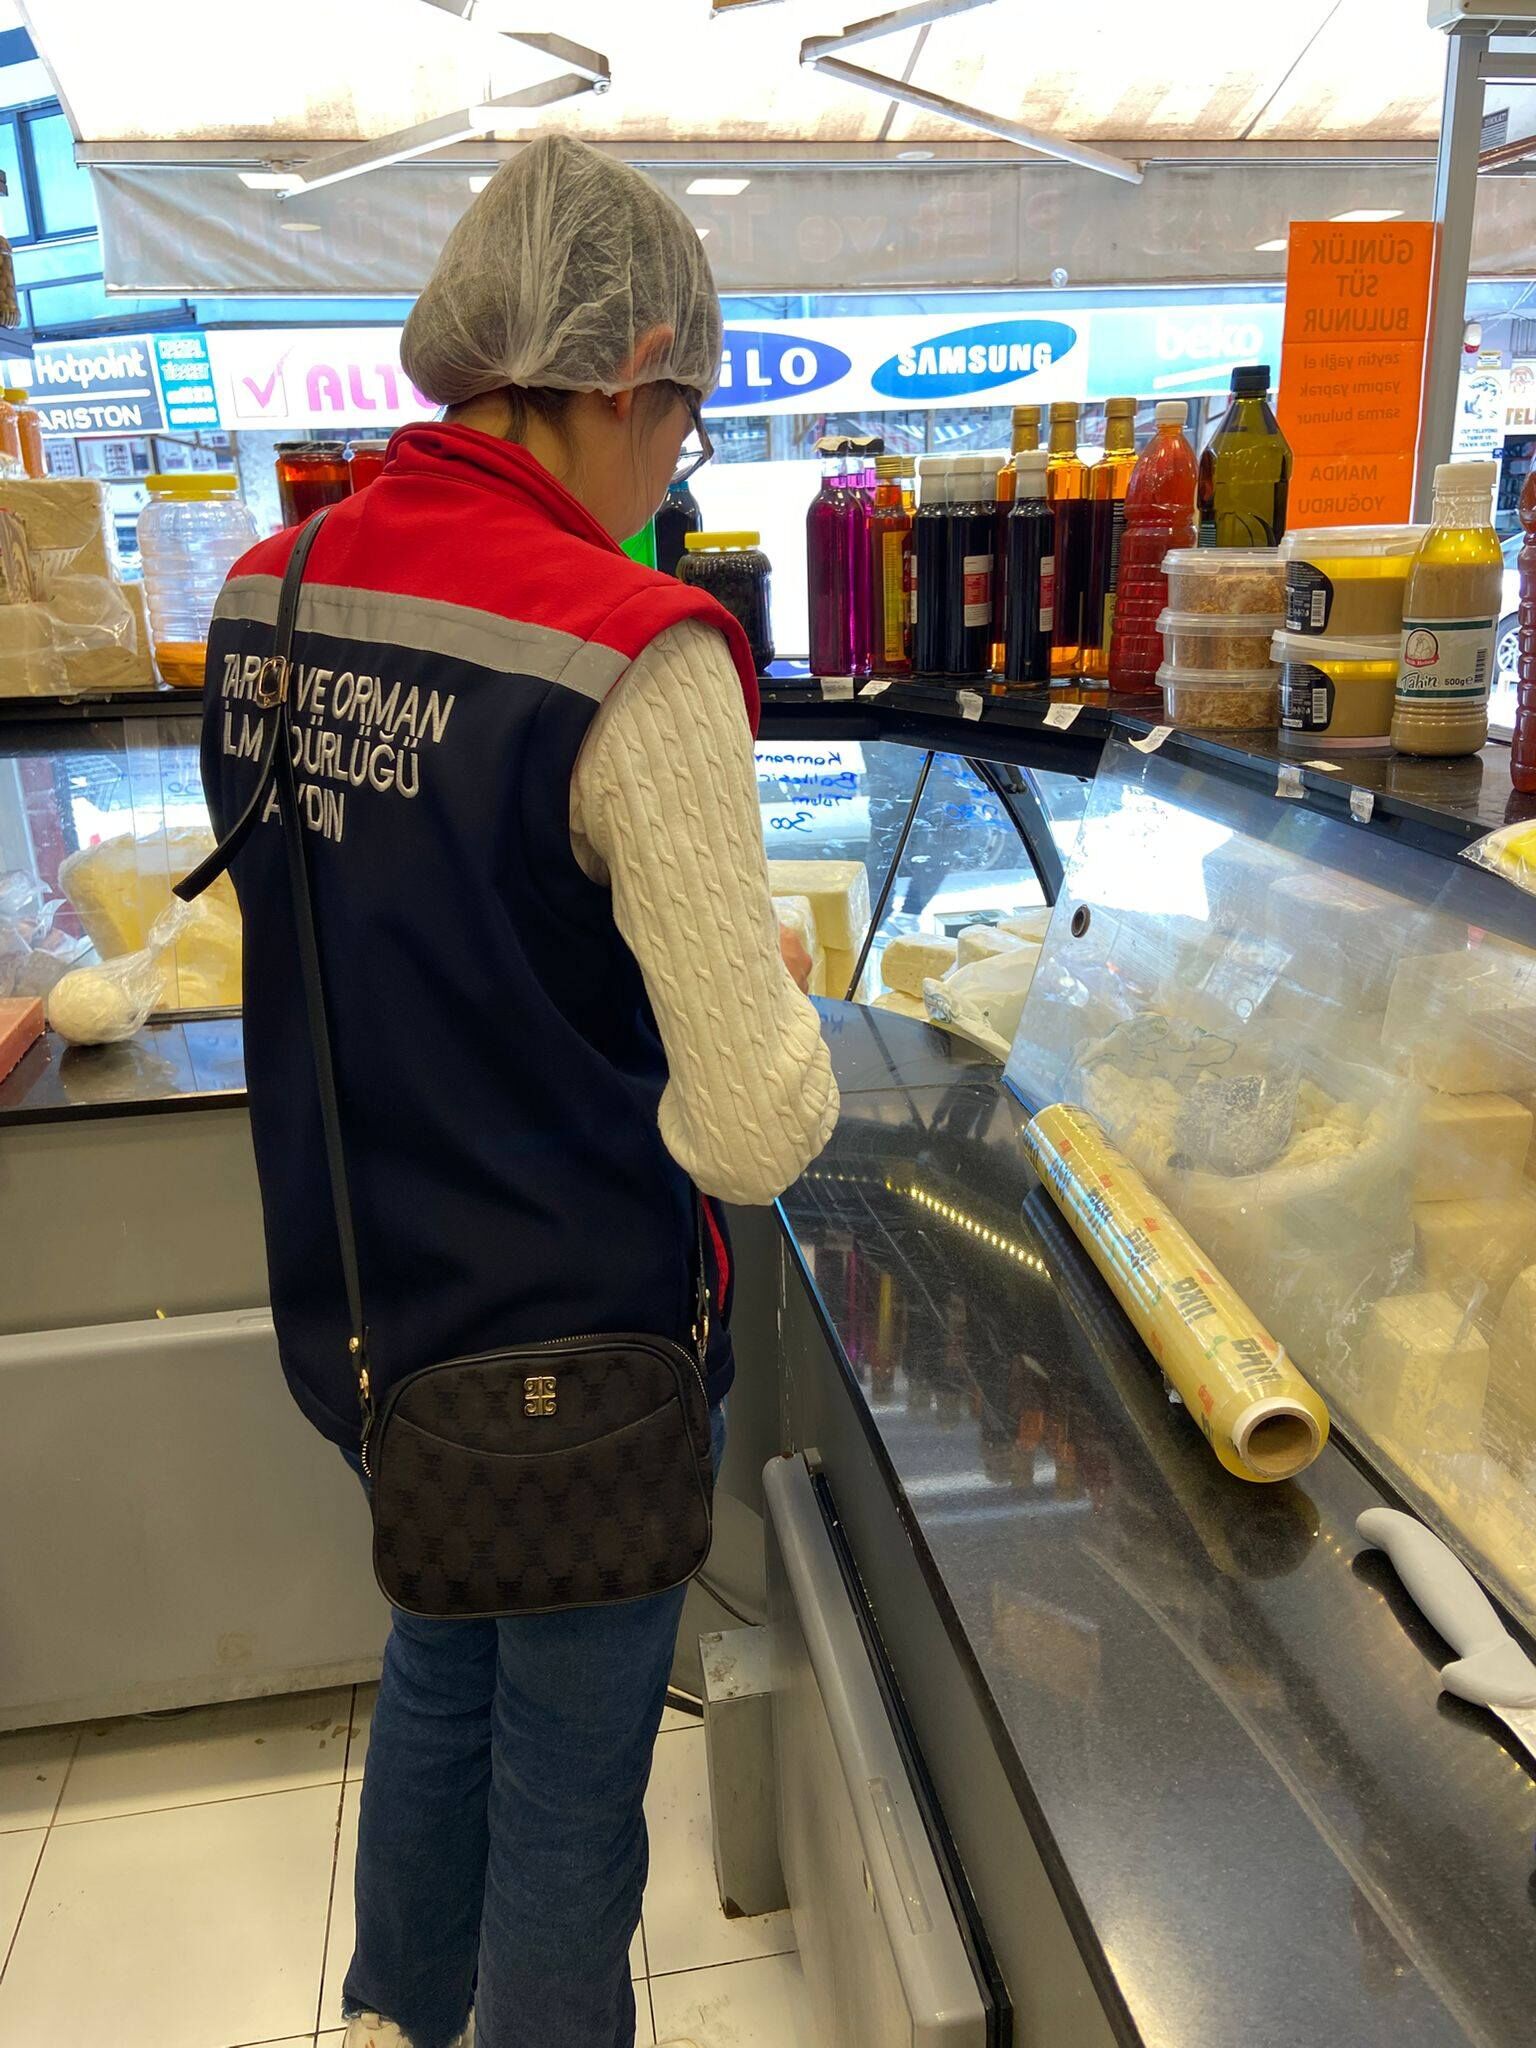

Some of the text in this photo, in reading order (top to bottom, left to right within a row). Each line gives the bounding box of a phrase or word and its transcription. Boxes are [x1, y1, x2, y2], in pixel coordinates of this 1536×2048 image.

[1155, 314, 1264, 360] beko
[34, 347, 148, 389] Hotpoint
[897, 342, 1052, 377] SAMSUNG
[306, 364, 440, 412] ALT
[38, 404, 143, 430] ARISTON
[1504, 407, 1536, 426] TEL
[222, 653, 456, 744] TAR VE ORMAN
[1400, 671, 1438, 692] Tahin
